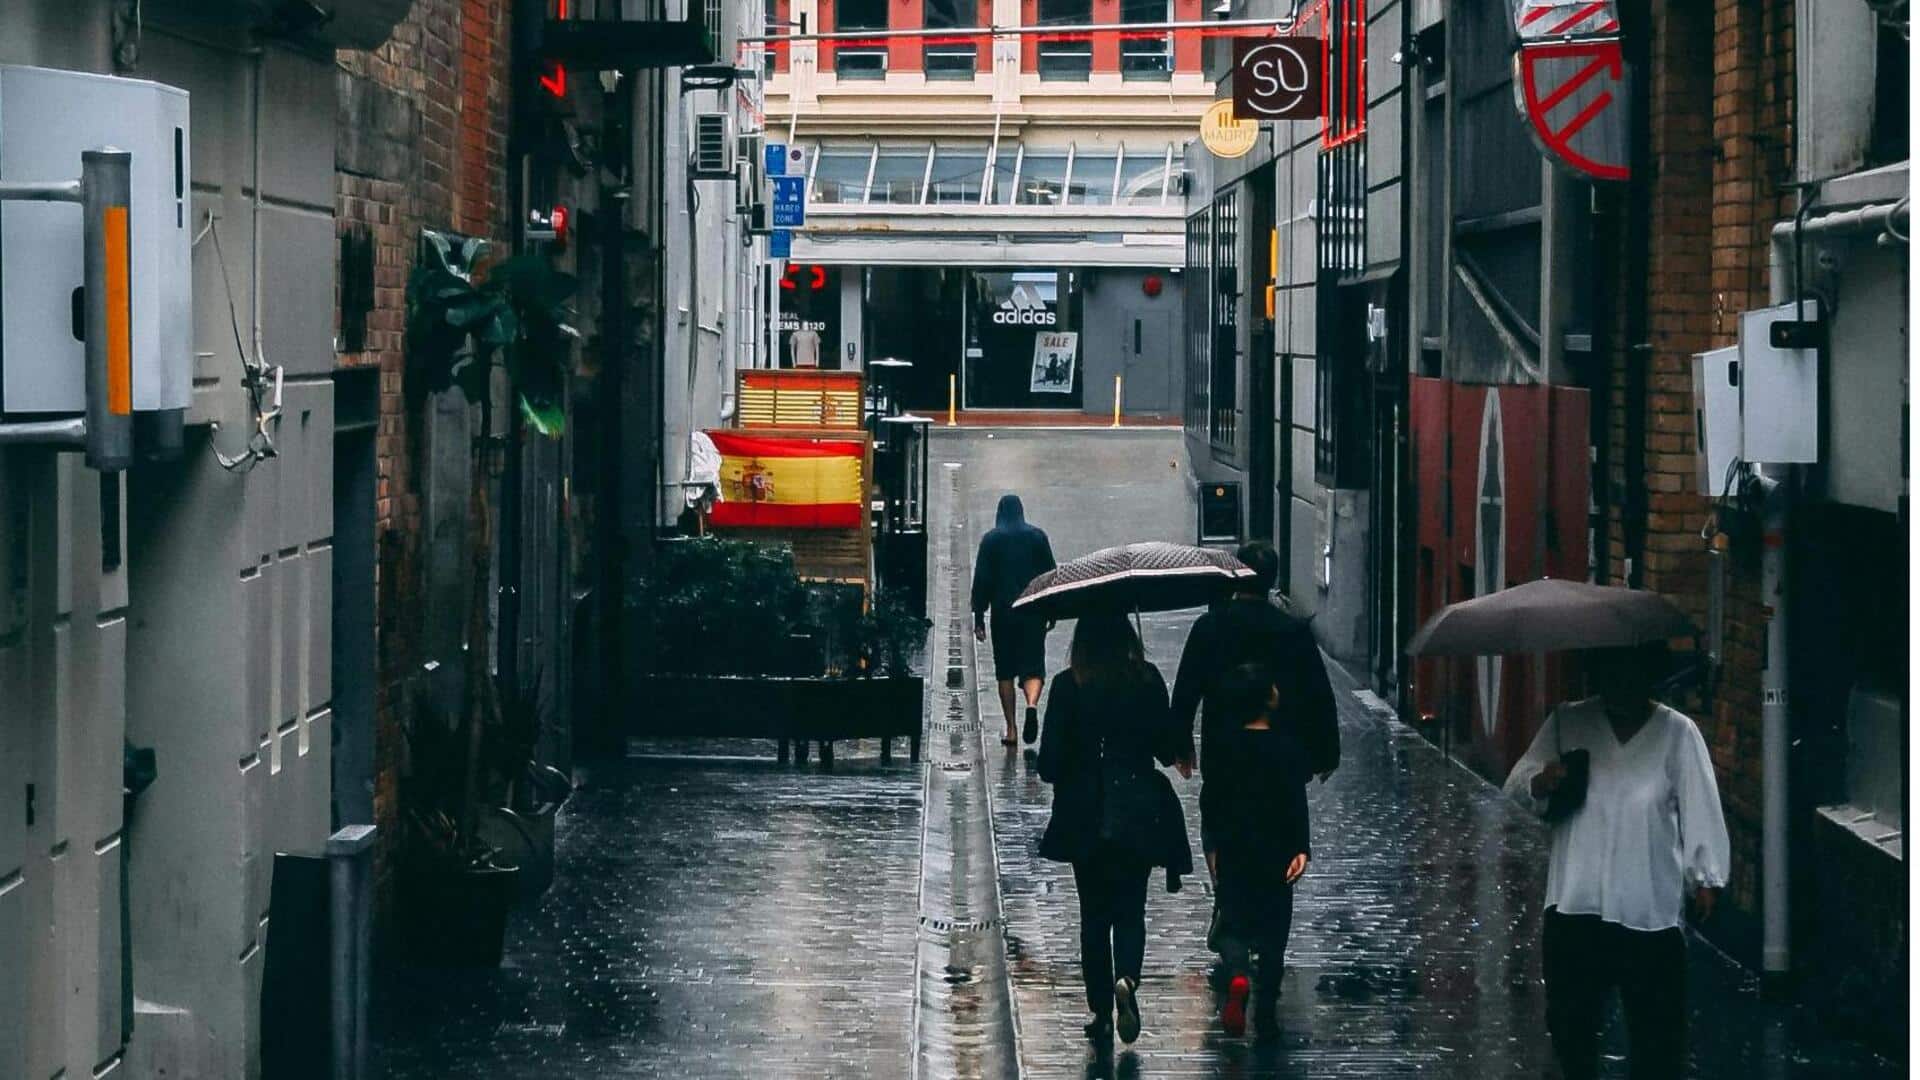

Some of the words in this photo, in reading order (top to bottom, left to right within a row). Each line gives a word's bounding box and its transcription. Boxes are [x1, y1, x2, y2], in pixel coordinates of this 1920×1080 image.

[775, 215, 794, 223] ZONE
[993, 309, 1056, 325] adidas
[1043, 336, 1069, 347] SALE
